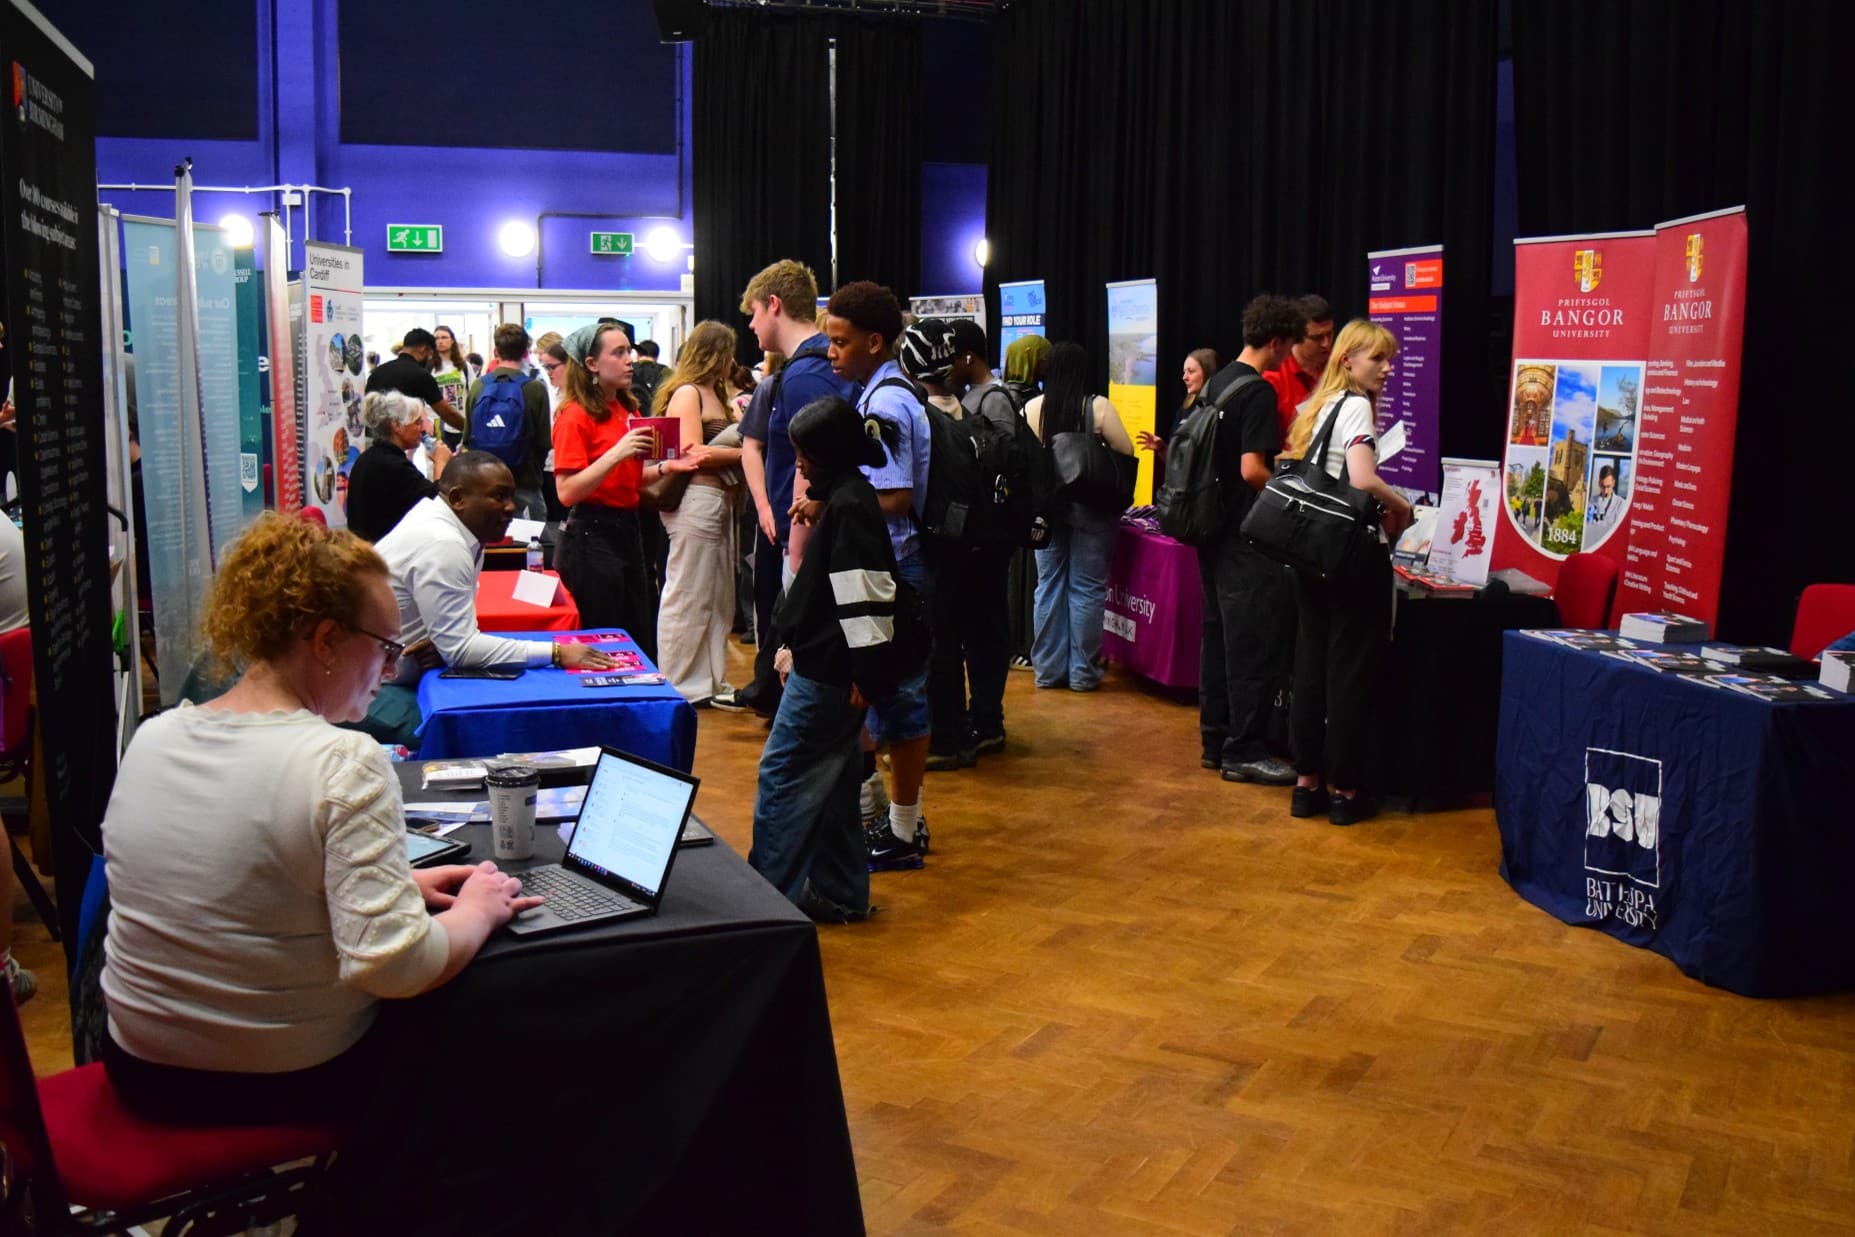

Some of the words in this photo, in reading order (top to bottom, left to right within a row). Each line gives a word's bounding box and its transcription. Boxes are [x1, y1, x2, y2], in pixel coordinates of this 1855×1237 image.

[310, 252, 343, 270] Universities
[344, 260, 350, 270] in
[310, 267, 330, 280] Cardiff
[1558, 298, 1611, 307] PRIFYSGOL
[1664, 300, 1712, 321] BANGOR
[1541, 309, 1625, 326] BANGOR
[1552, 329, 1611, 338] UNIVERSITY
[1547, 527, 1577, 546] 1884
